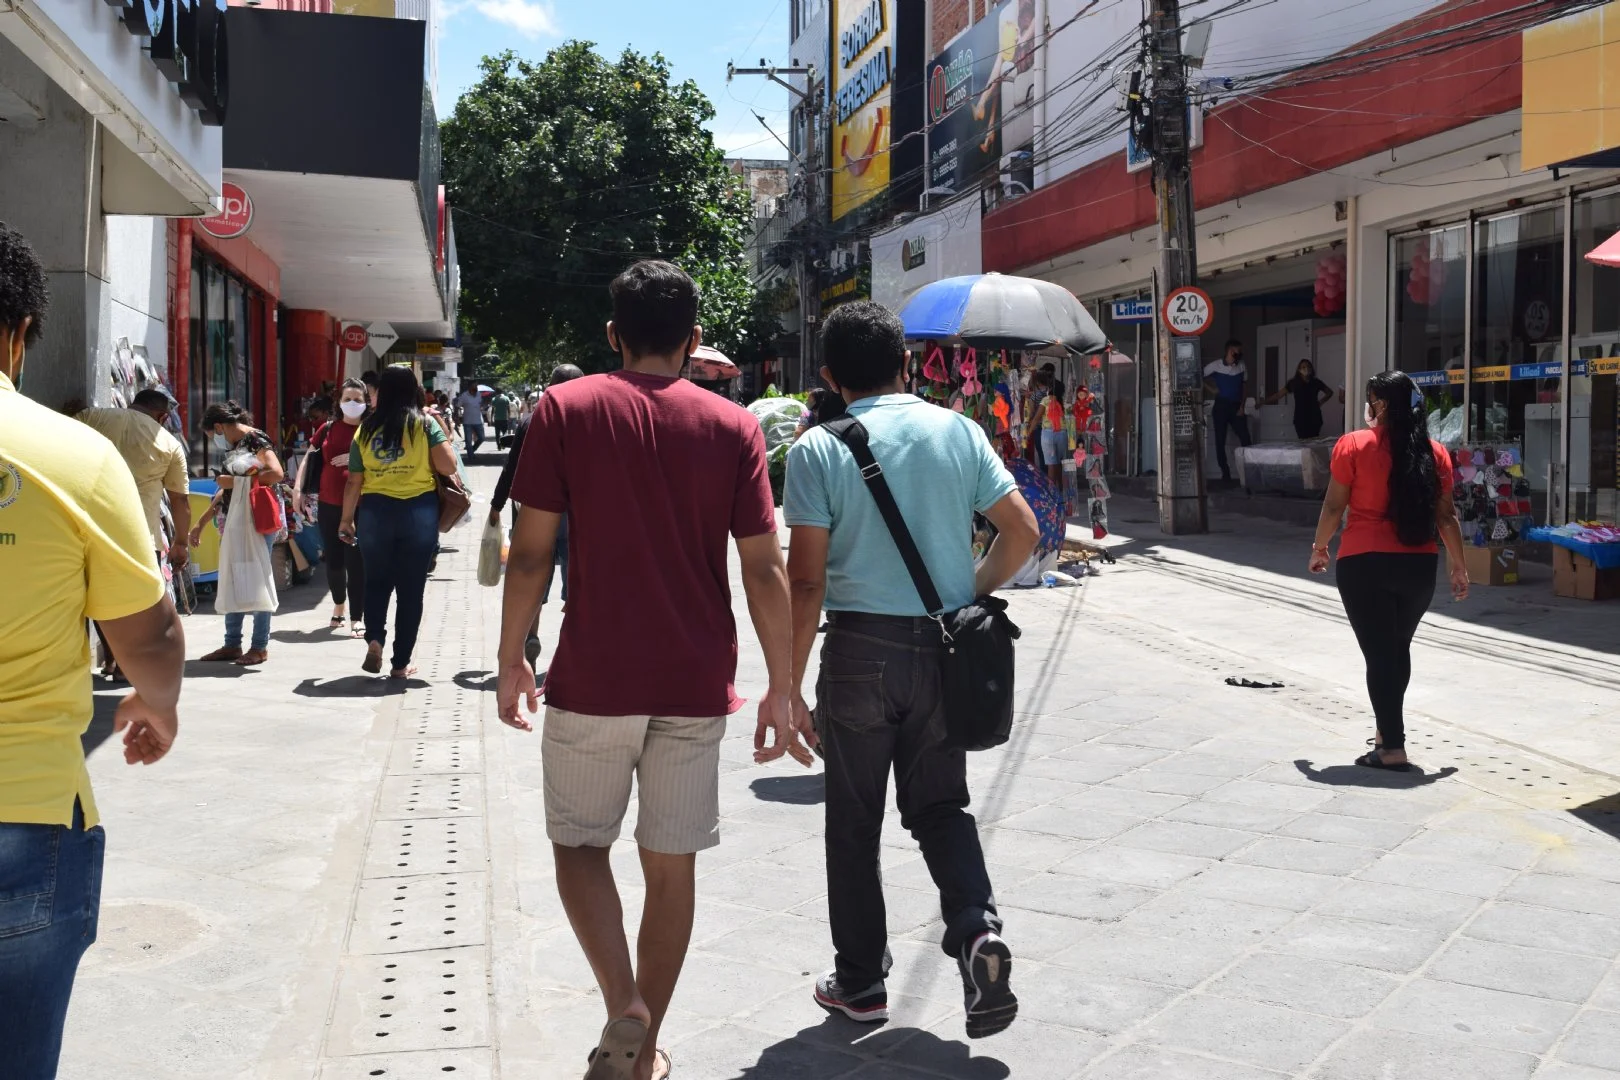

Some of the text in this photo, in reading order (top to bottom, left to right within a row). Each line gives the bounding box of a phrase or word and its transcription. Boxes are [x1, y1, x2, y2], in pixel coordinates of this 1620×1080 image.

[841, 0, 884, 69] SORRIA
[835, 46, 889, 126] TERESINA
[946, 85, 967, 110] CALÇADOS
[1116, 302, 1152, 316] Lilian
[1176, 295, 1199, 313] 20
[1173, 315, 1203, 325] Km/h
